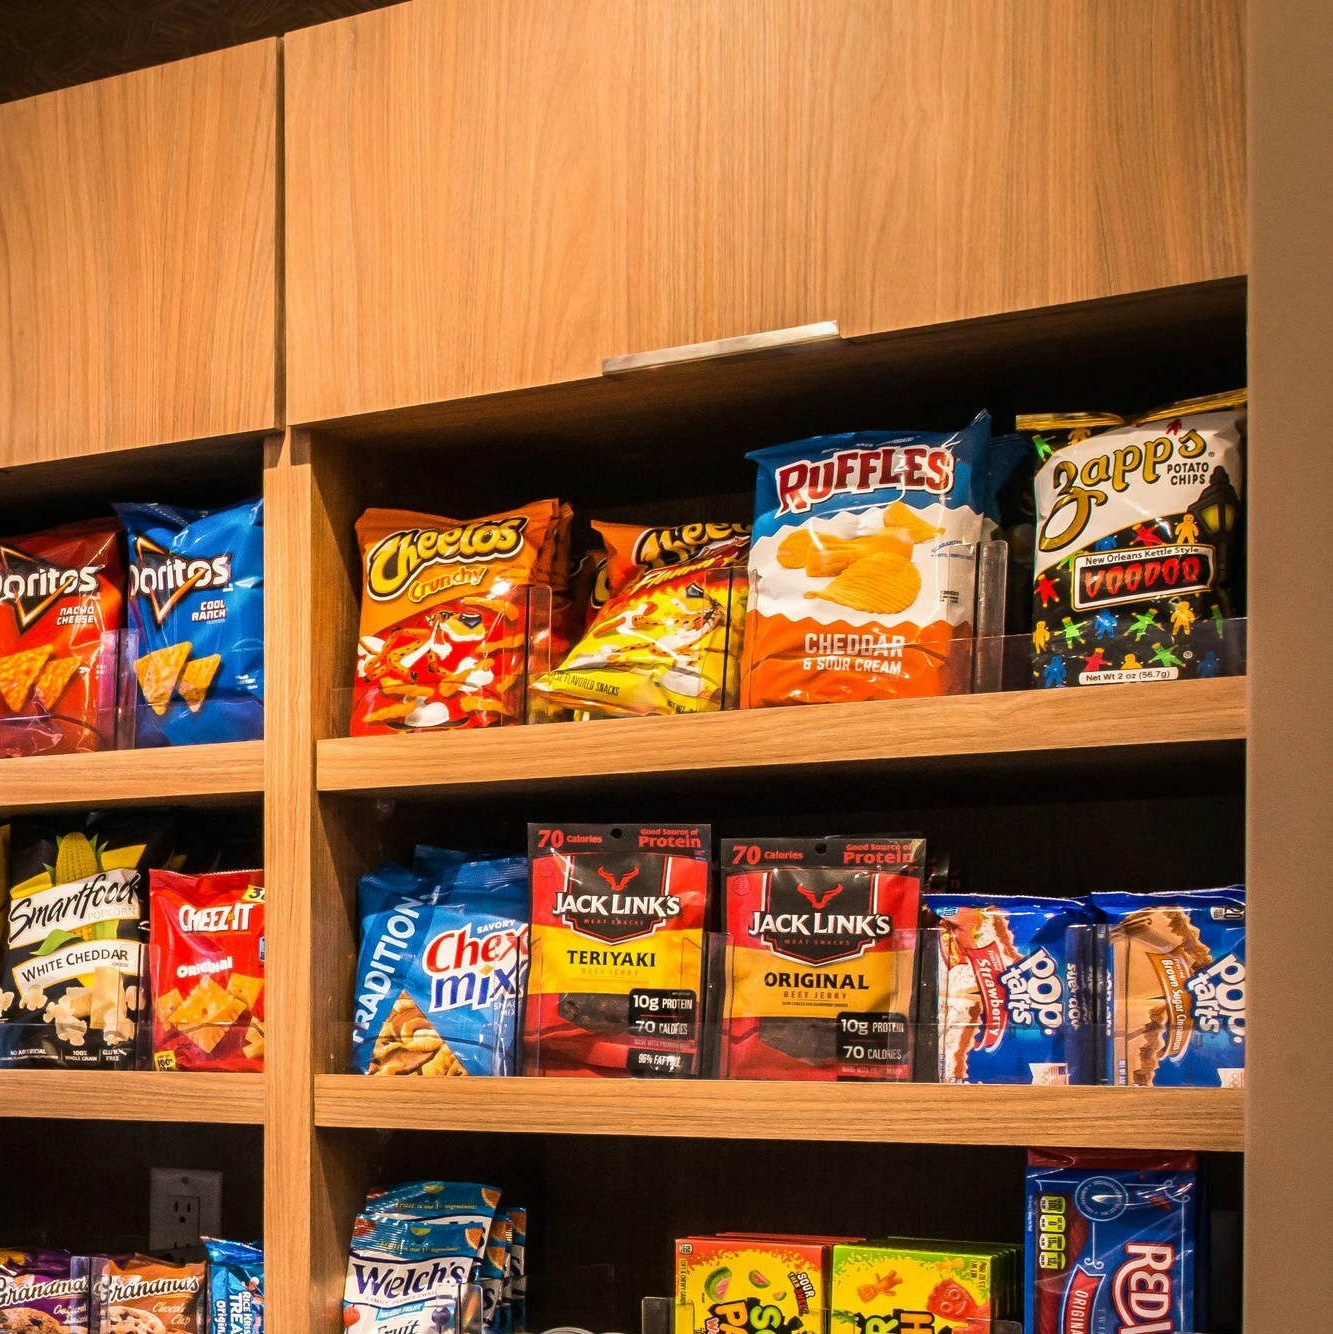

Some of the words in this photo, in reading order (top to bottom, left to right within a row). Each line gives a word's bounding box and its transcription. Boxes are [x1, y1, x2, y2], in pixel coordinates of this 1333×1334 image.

[1167, 462, 1209, 476] POTATO
[775, 447, 951, 513] RUFFLES
[1170, 473, 1206, 486] CHIPS
[1039, 427, 1207, 551] Zapp's
[367, 516, 531, 600] Cheetos
[1086, 554, 1104, 566] New
[1107, 551, 1142, 563] Orleans
[1144, 549, 1172, 560] Kettle
[1175, 545, 1199, 557] Style
[408, 566, 488, 602] Crunchy
[1083, 557, 1201, 598] VOODOO
[60, 607, 94, 616] NACHO
[201, 600, 225, 610] COOL
[57, 615, 94, 625] CHEESE
[191, 609, 226, 622] RANCH
[804, 633, 904, 657] CHEDDAR
[538, 829, 563, 848] 70
[566, 834, 603, 844] Calories
[639, 835, 702, 849] Protein
[733, 846, 761, 864] 70
[764, 851, 803, 860] Calories
[843, 851, 915, 864] Protein
[8, 870, 141, 943] Smartfood
[88, 906, 139, 920] POPCORN
[552, 893, 609, 915] JACK
[612, 895, 680, 916] LINK'S
[749, 912, 811, 936] JACK
[814, 913, 891, 936] LINK'S
[425, 923, 528, 973] Chex
[21, 959, 63, 983] WHITE
[66, 948, 128, 966] CHEDDAR
[567, 951, 656, 968] TERIYAKI
[764, 972, 870, 989] ORIGINAL
[633, 995, 659, 1011] 10g
[662, 999, 692, 1010] PROTEIN
[784, 991, 809, 999] BEEF
[814, 992, 848, 1000] JERKY
[976, 958, 1000, 1037] Strawberry
[635, 1020, 655, 1034] 70
[658, 1023, 688, 1035] CALORIES
[840, 1018, 869, 1035] 10g
[872, 1022, 904, 1032] PROTEIN
[843, 1046, 865, 1059] 70
[867, 1049, 901, 1060] CALORIES
[352, 1261, 466, 1299] Welch's
[1112, 1242, 1173, 1326] RED
